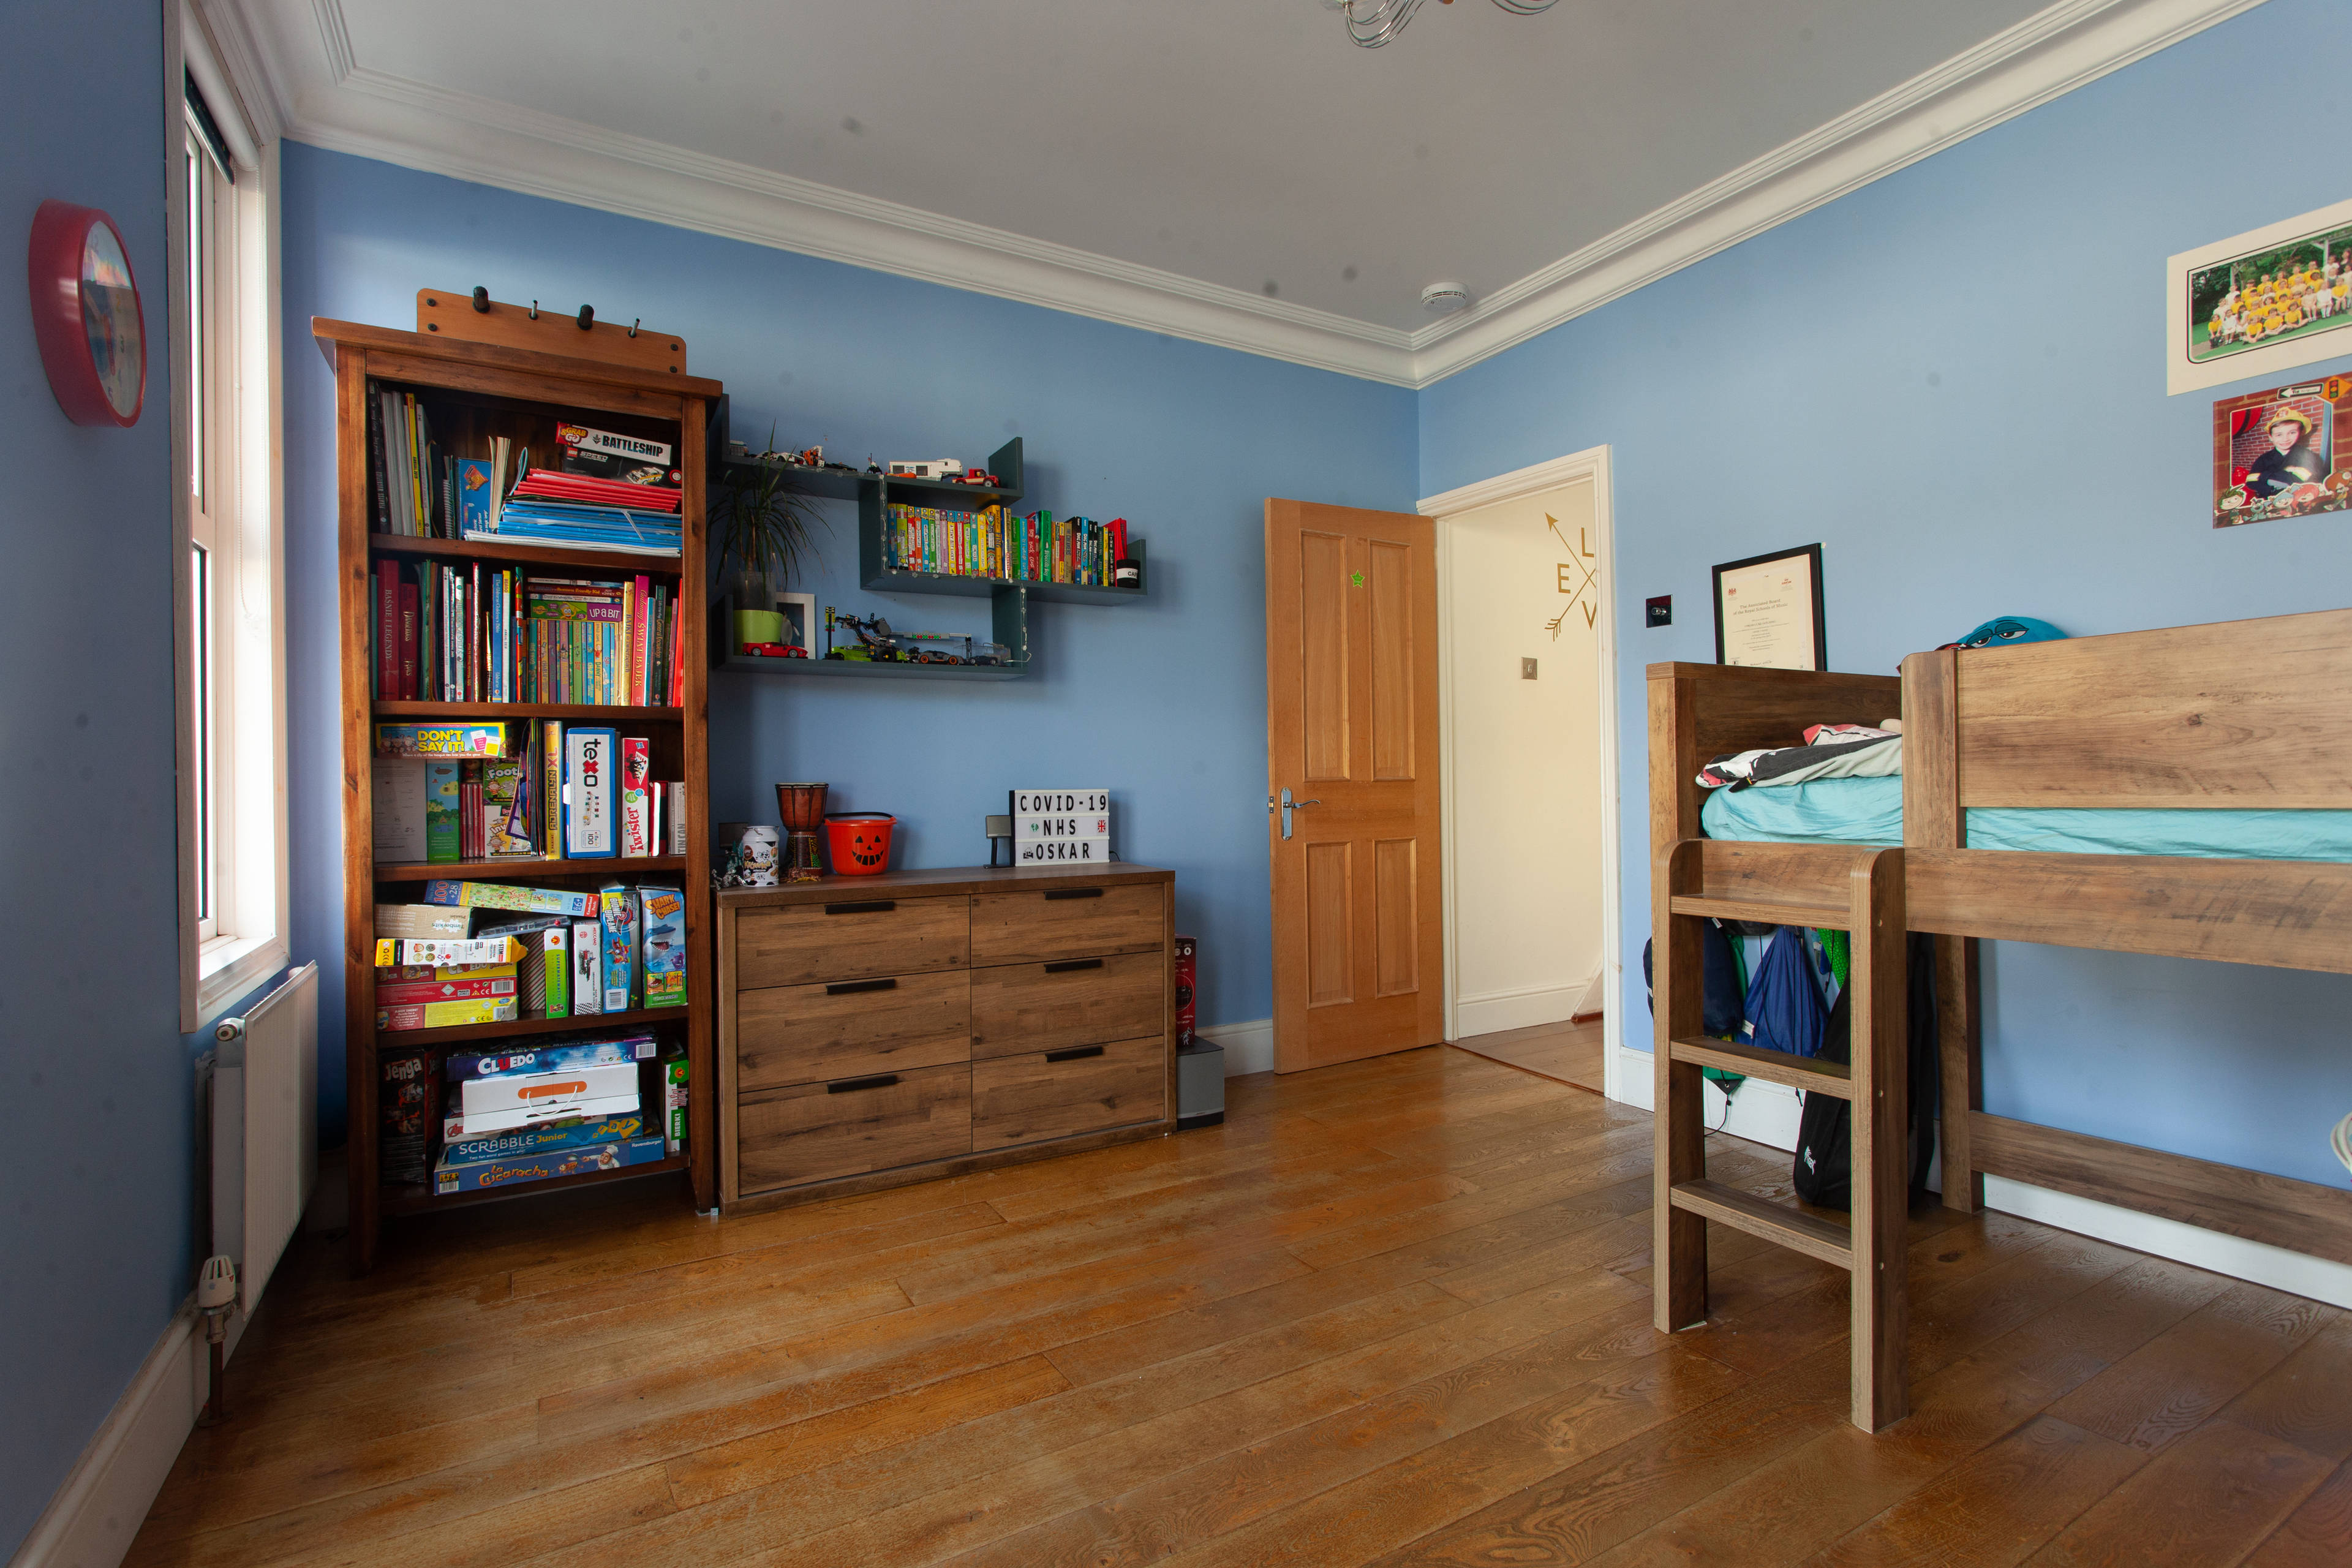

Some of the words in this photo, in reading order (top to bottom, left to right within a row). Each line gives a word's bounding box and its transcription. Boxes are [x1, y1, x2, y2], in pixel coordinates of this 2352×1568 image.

[565, 434, 581, 443] GO
[566, 427, 587, 437] GRAB
[579, 451, 609, 461] SPEED
[602, 435, 663, 457] BATTLESHIP
[1557, 563, 1571, 594] E
[385, 590, 394, 617] BAŚNIE
[589, 608, 600, 617] UP
[608, 609, 620, 619] BIT
[636, 622, 646, 653] ŚWIAT
[417, 729, 464, 742] DON'T
[417, 741, 445, 753] SAY
[448, 741, 466, 752] IT!
[547, 747, 558, 769] XL
[582, 739, 601, 788] texo
[488, 766, 518, 779] Foot
[548, 770, 558, 830] ADRENALYN
[1020, 794, 1106, 812] COVID-19
[627, 807, 644, 854] Twister
[1043, 819, 1076, 836] NHS
[1036, 843, 1090, 860] OSKAR
[433, 881, 450, 903] 100
[609, 897, 622, 916] BIONIC
[644, 894, 676, 914] SHARK
[655, 901, 680, 920] CHASE!
[604, 910, 617, 933] BIPLANE
[385, 1058, 422, 1081] Jenga
[477, 1052, 536, 1076] CLUEDO
[459, 1134, 535, 1156] SCRABBLE
[536, 1132, 568, 1145] Junior
[631, 1140, 662, 1148] Ravensburger
[478, 1164, 549, 1186] Cucaracha
[491, 1165, 503, 1174] La
